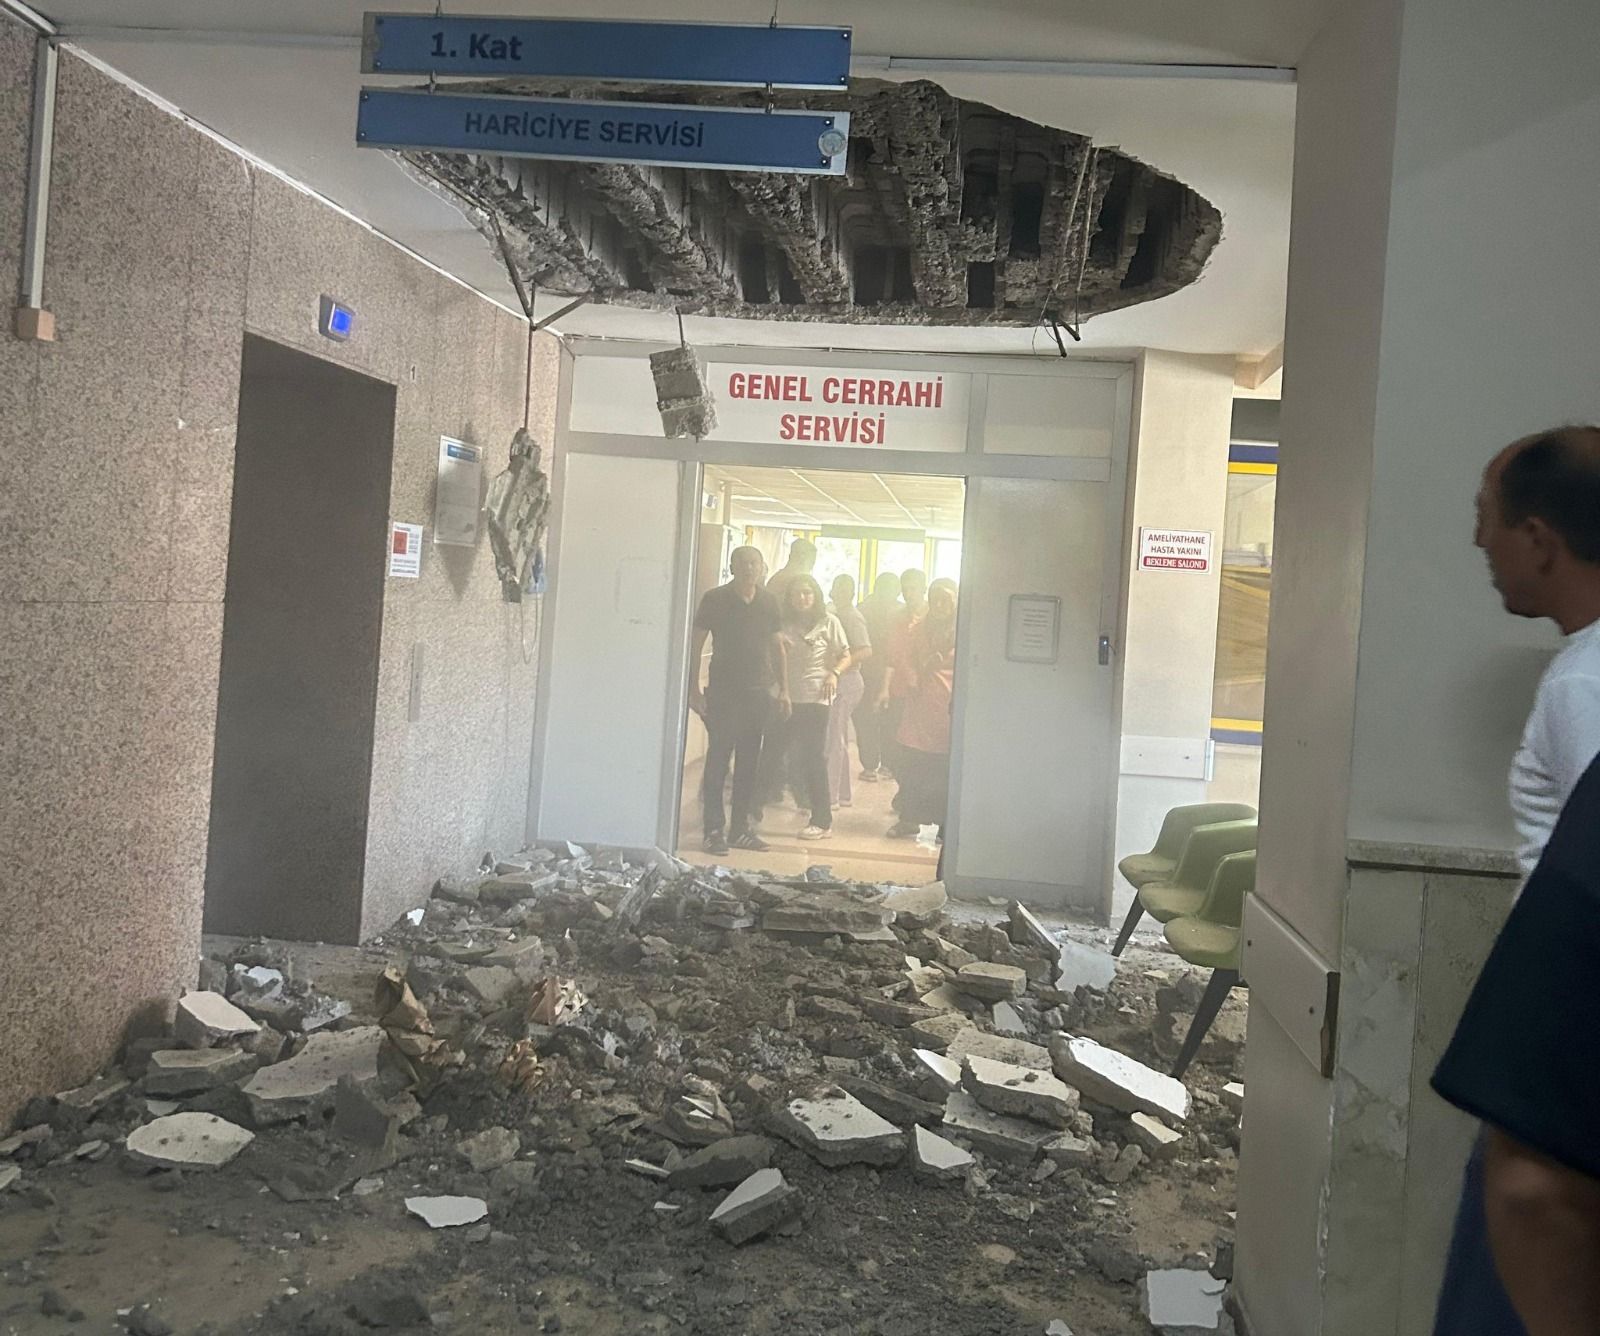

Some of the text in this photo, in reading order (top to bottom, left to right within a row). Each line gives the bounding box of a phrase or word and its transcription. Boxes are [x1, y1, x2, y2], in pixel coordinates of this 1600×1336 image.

[430, 33, 523, 61] 1. Kat
[465, 111, 704, 148] HARİCİYE SERVİSİ
[728, 372, 943, 408] GENEL CERRAHİ
[779, 411, 886, 444] SERVİSİ
[1148, 533, 1206, 544] AMELİYATHANE
[1150, 546, 1202, 556] HASTA YAKINI
[1146, 557, 1205, 569] BEKLEME SALONU
